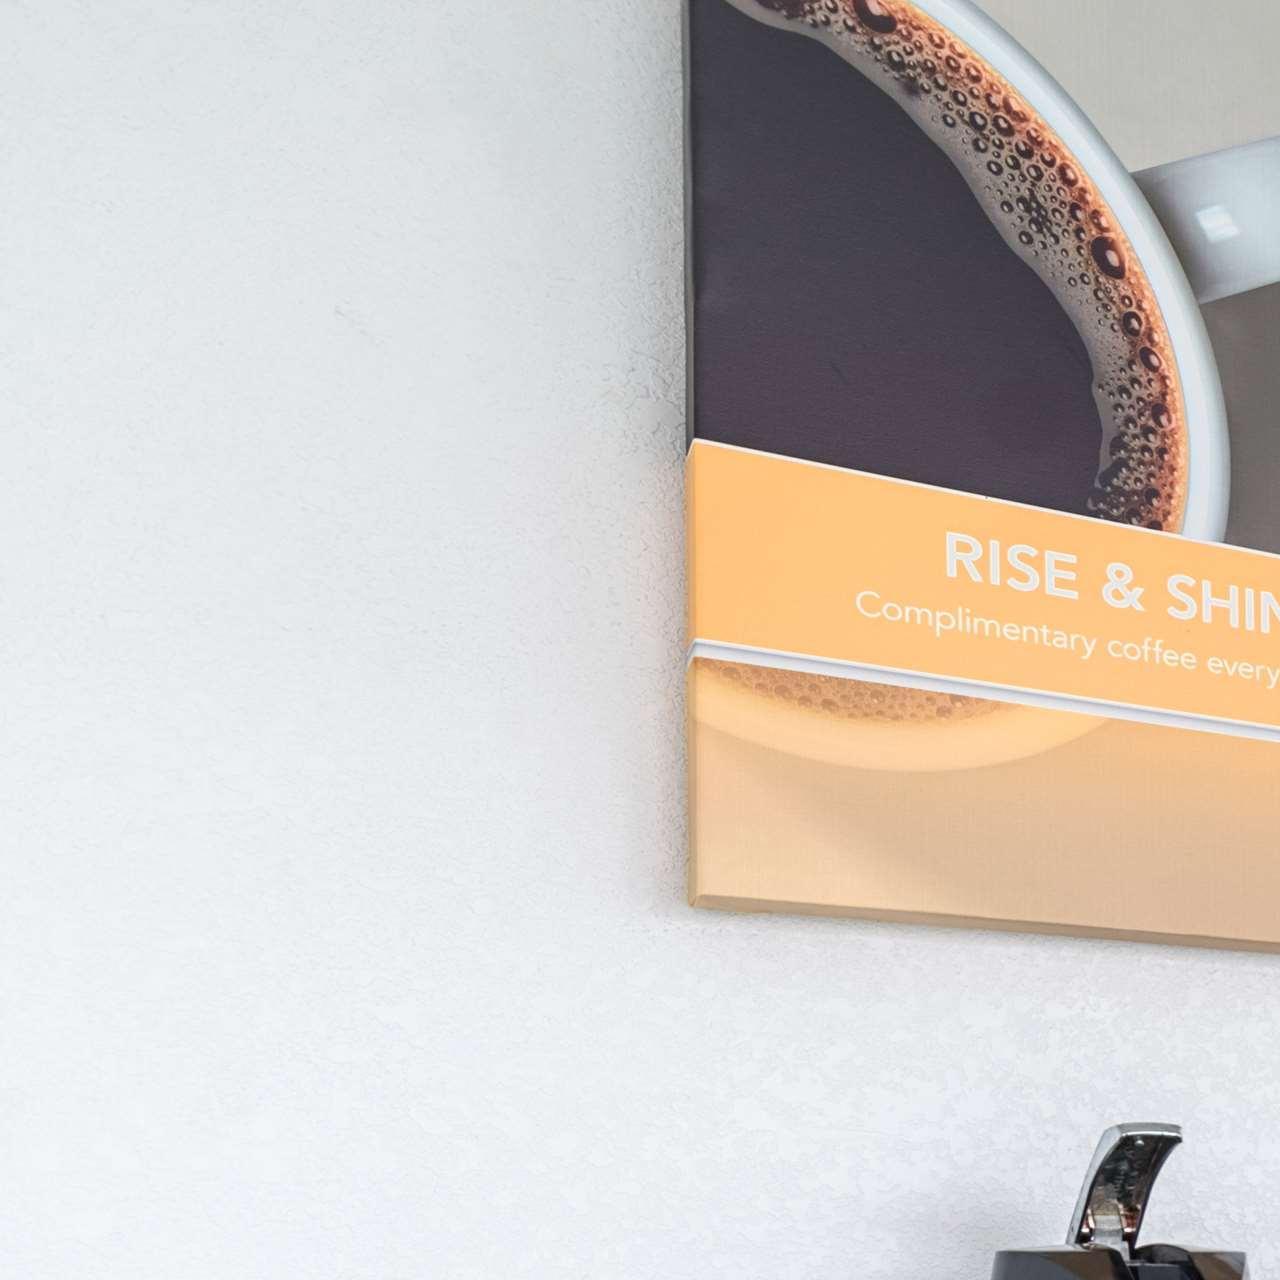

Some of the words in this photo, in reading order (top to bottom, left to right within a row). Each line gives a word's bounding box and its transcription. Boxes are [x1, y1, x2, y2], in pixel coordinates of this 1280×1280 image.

[945, 531, 1079, 600] RISE
[1102, 562, 1146, 612] &
[855, 591, 1098, 660] Complimentary
[1107, 637, 1197, 670] coffee
